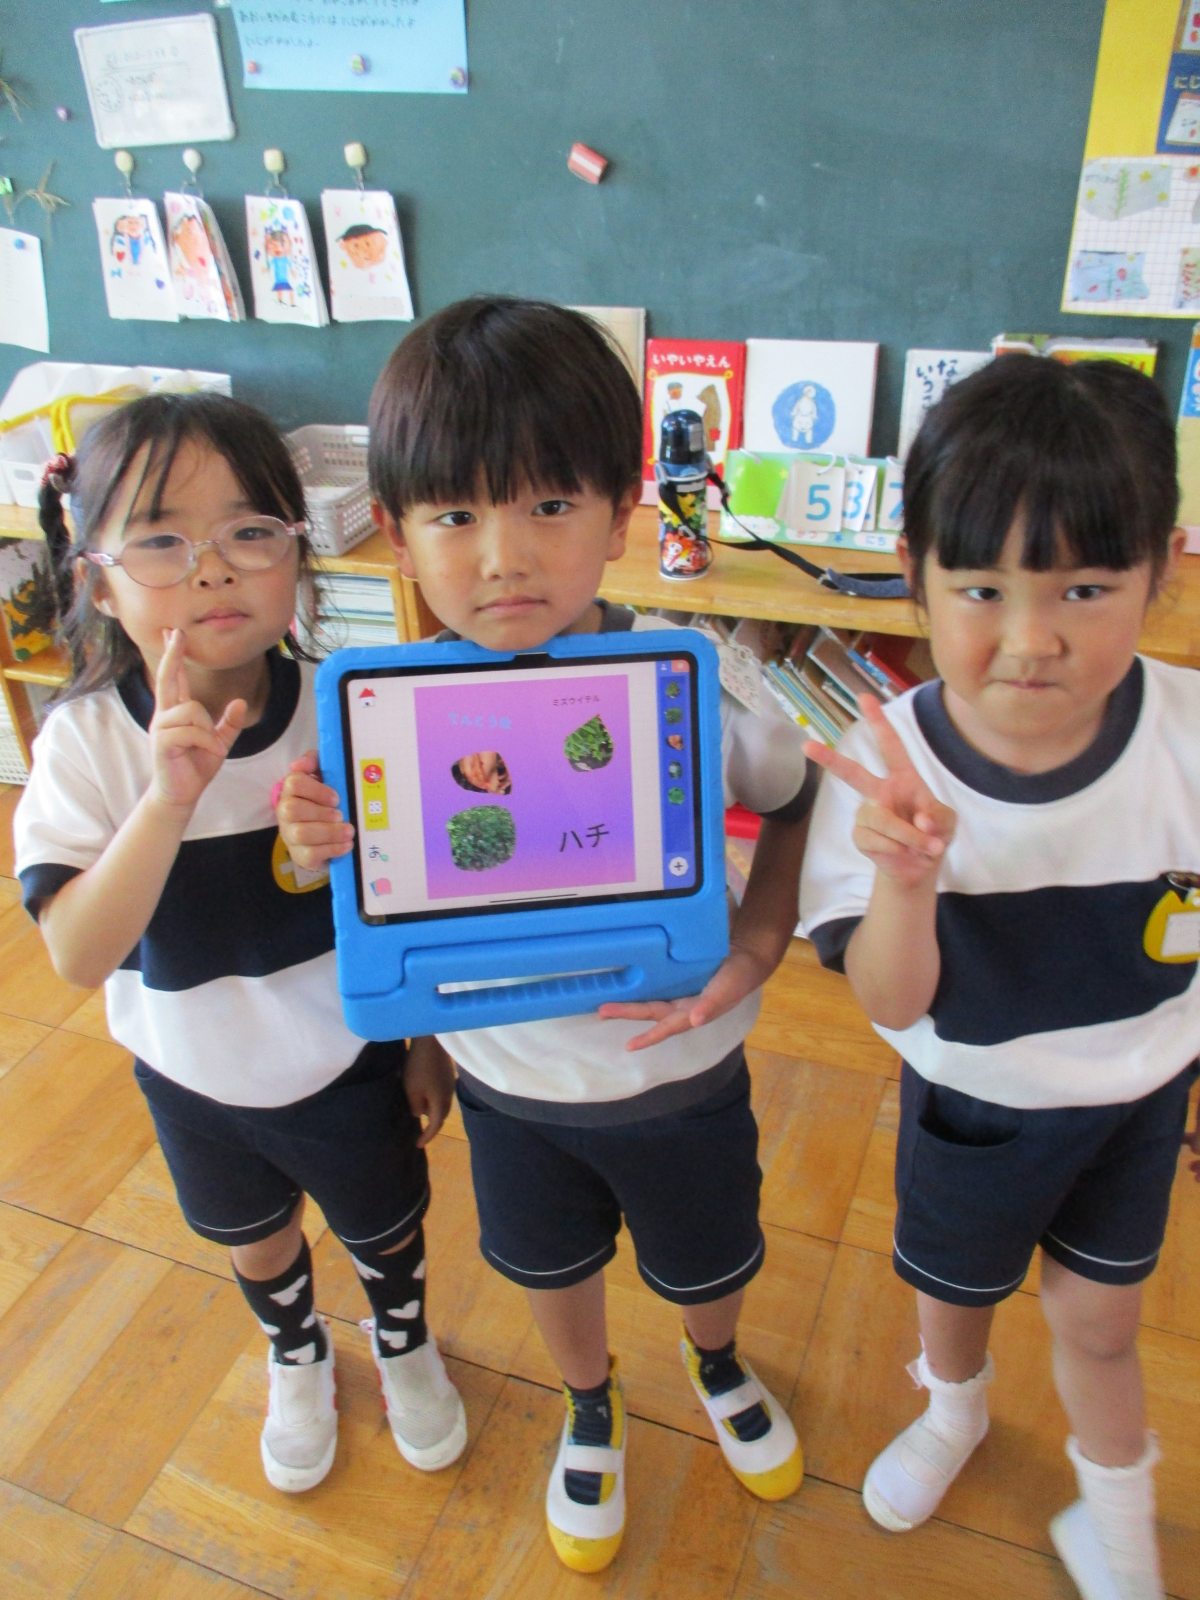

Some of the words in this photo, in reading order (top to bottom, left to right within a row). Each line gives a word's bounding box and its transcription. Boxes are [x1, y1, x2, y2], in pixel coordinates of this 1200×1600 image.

[652, 353, 731, 368] いやいやえん
[806, 484, 831, 521] 5
[843, 481, 865, 519] 3
[560, 824, 609, 852] ハチ
